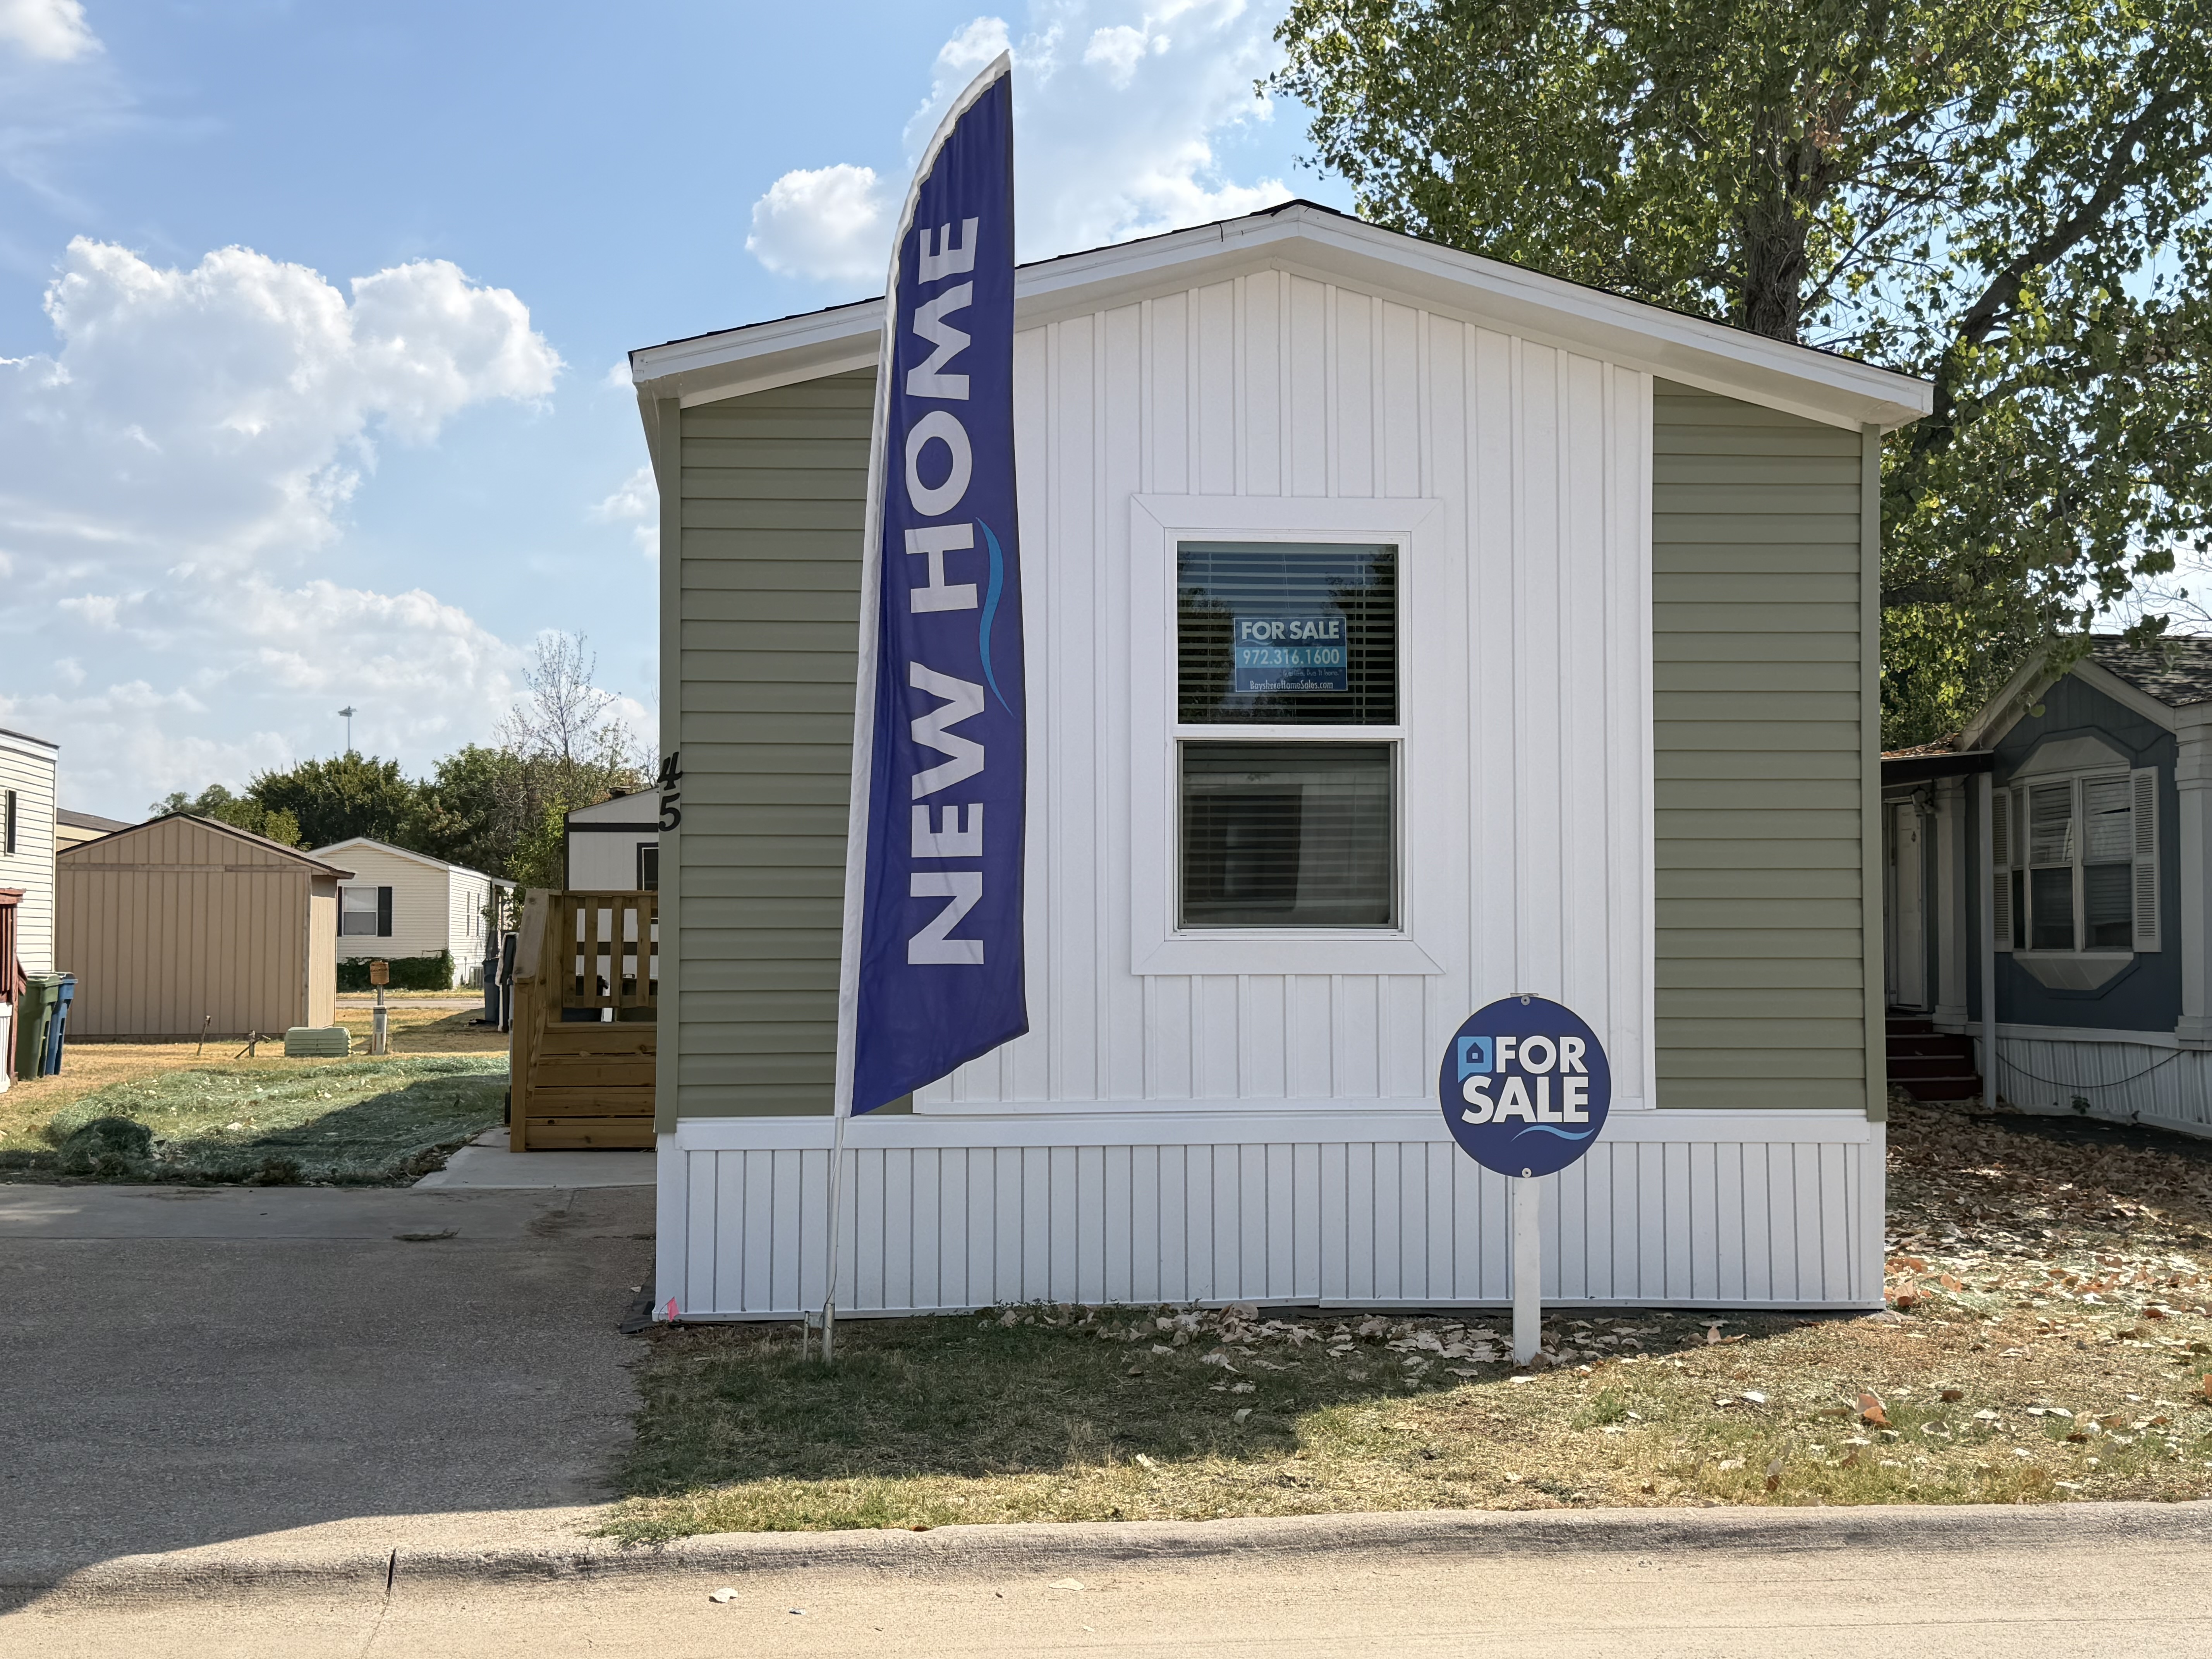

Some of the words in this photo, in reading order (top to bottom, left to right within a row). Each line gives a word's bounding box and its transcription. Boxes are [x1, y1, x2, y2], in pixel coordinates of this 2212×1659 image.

[905, 216, 979, 613] HOME
[1242, 621, 1286, 640] FOR
[1290, 621, 1340, 639] SALE
[1243, 649, 1340, 665] 972.316.1600
[908, 661, 984, 965] NEW
[1496, 1035, 1589, 1074] FOR
[1462, 1075, 1589, 1124] SALE
